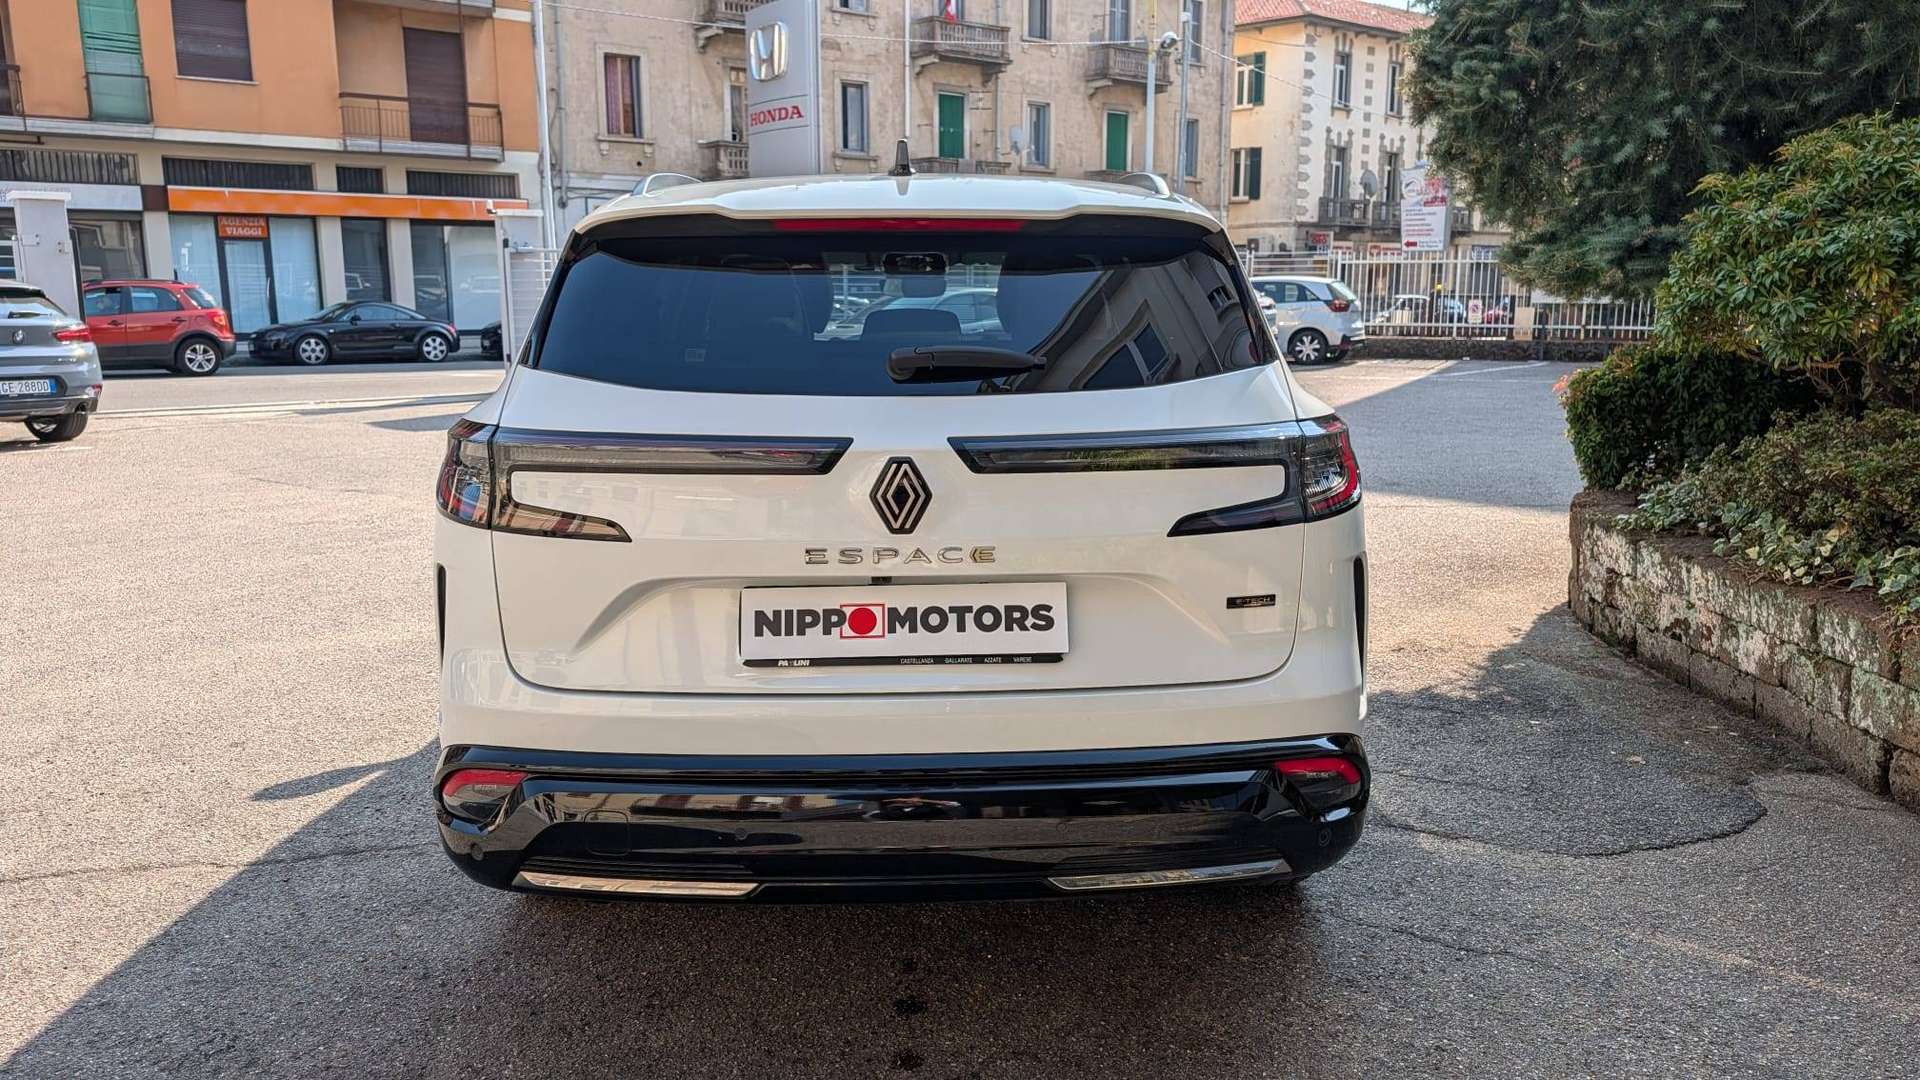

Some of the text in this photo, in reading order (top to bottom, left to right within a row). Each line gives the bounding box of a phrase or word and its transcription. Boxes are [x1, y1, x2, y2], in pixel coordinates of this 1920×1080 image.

[750, 105, 804, 127] HONDA
[221, 216, 265, 226] AGENZIA
[225, 227, 262, 236] VIAGGI
[18, 381, 49, 393] 288DD
[804, 545, 996, 565] ESPACE
[887, 603, 1056, 635] MOTORS
[900, 657, 934, 665] CASTELLANZA
[984, 656, 1002, 664] AZZATE
